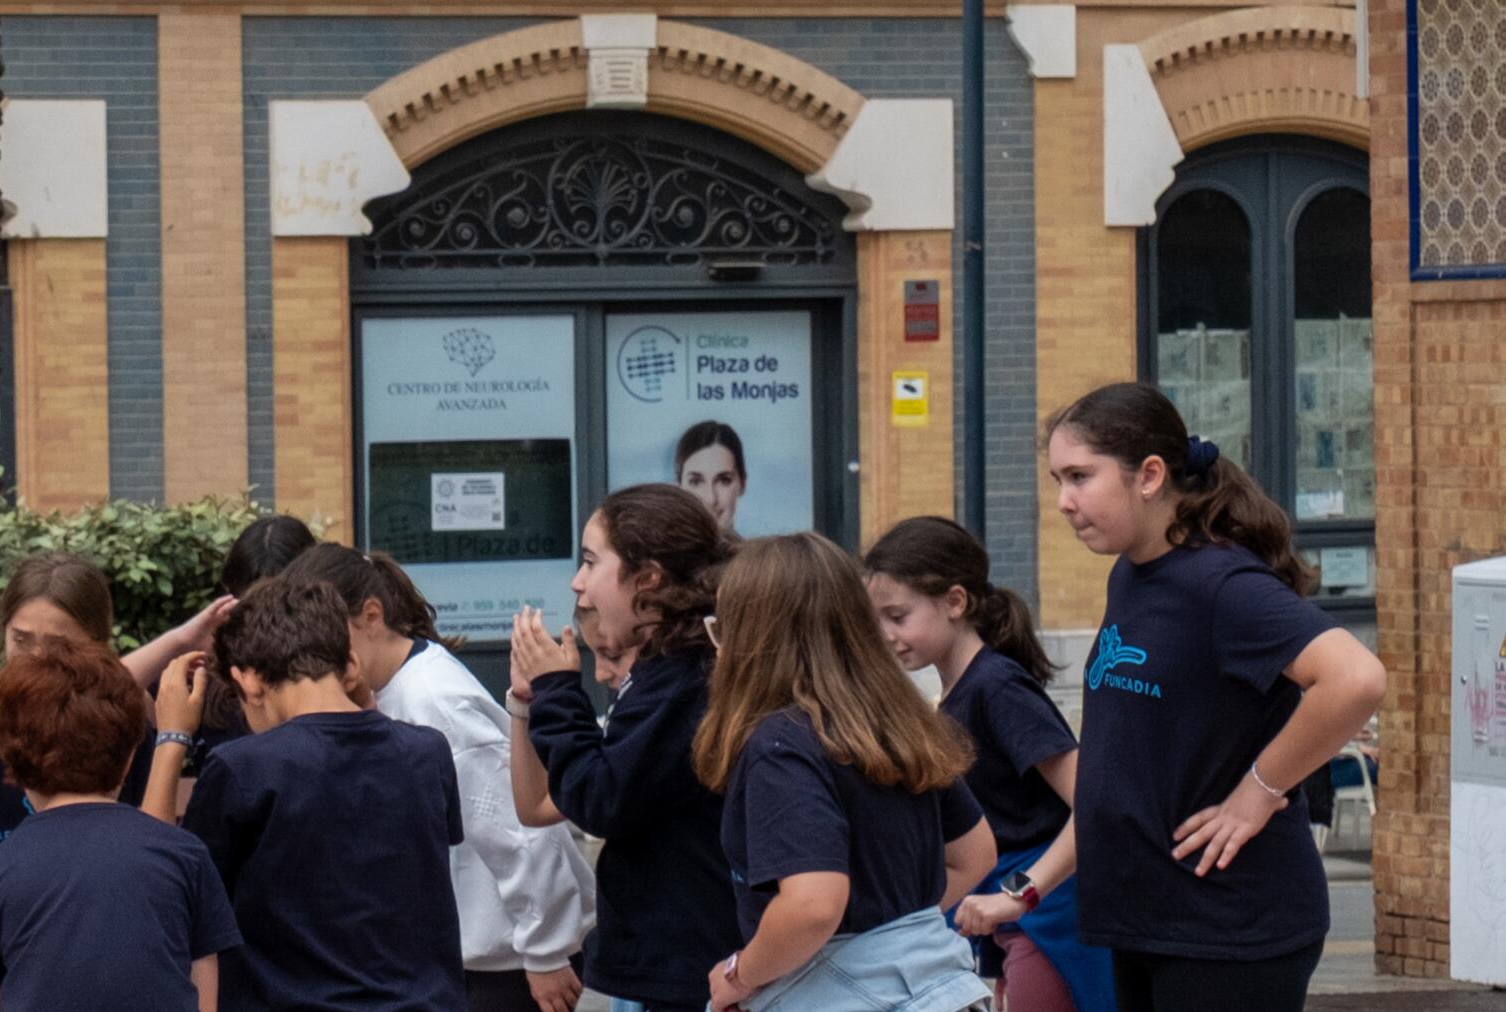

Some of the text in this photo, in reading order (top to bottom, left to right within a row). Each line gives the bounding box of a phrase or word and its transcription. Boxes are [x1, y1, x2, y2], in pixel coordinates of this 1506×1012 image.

[697, 354, 779, 374] Plaza de
[387, 378, 551, 396] CENTRO DE NEUROLOGÍA
[697, 380, 800, 404] las Monjas
[436, 399, 508, 411] AVANZADA
[1104, 672, 1162, 698] FUNCADIA
